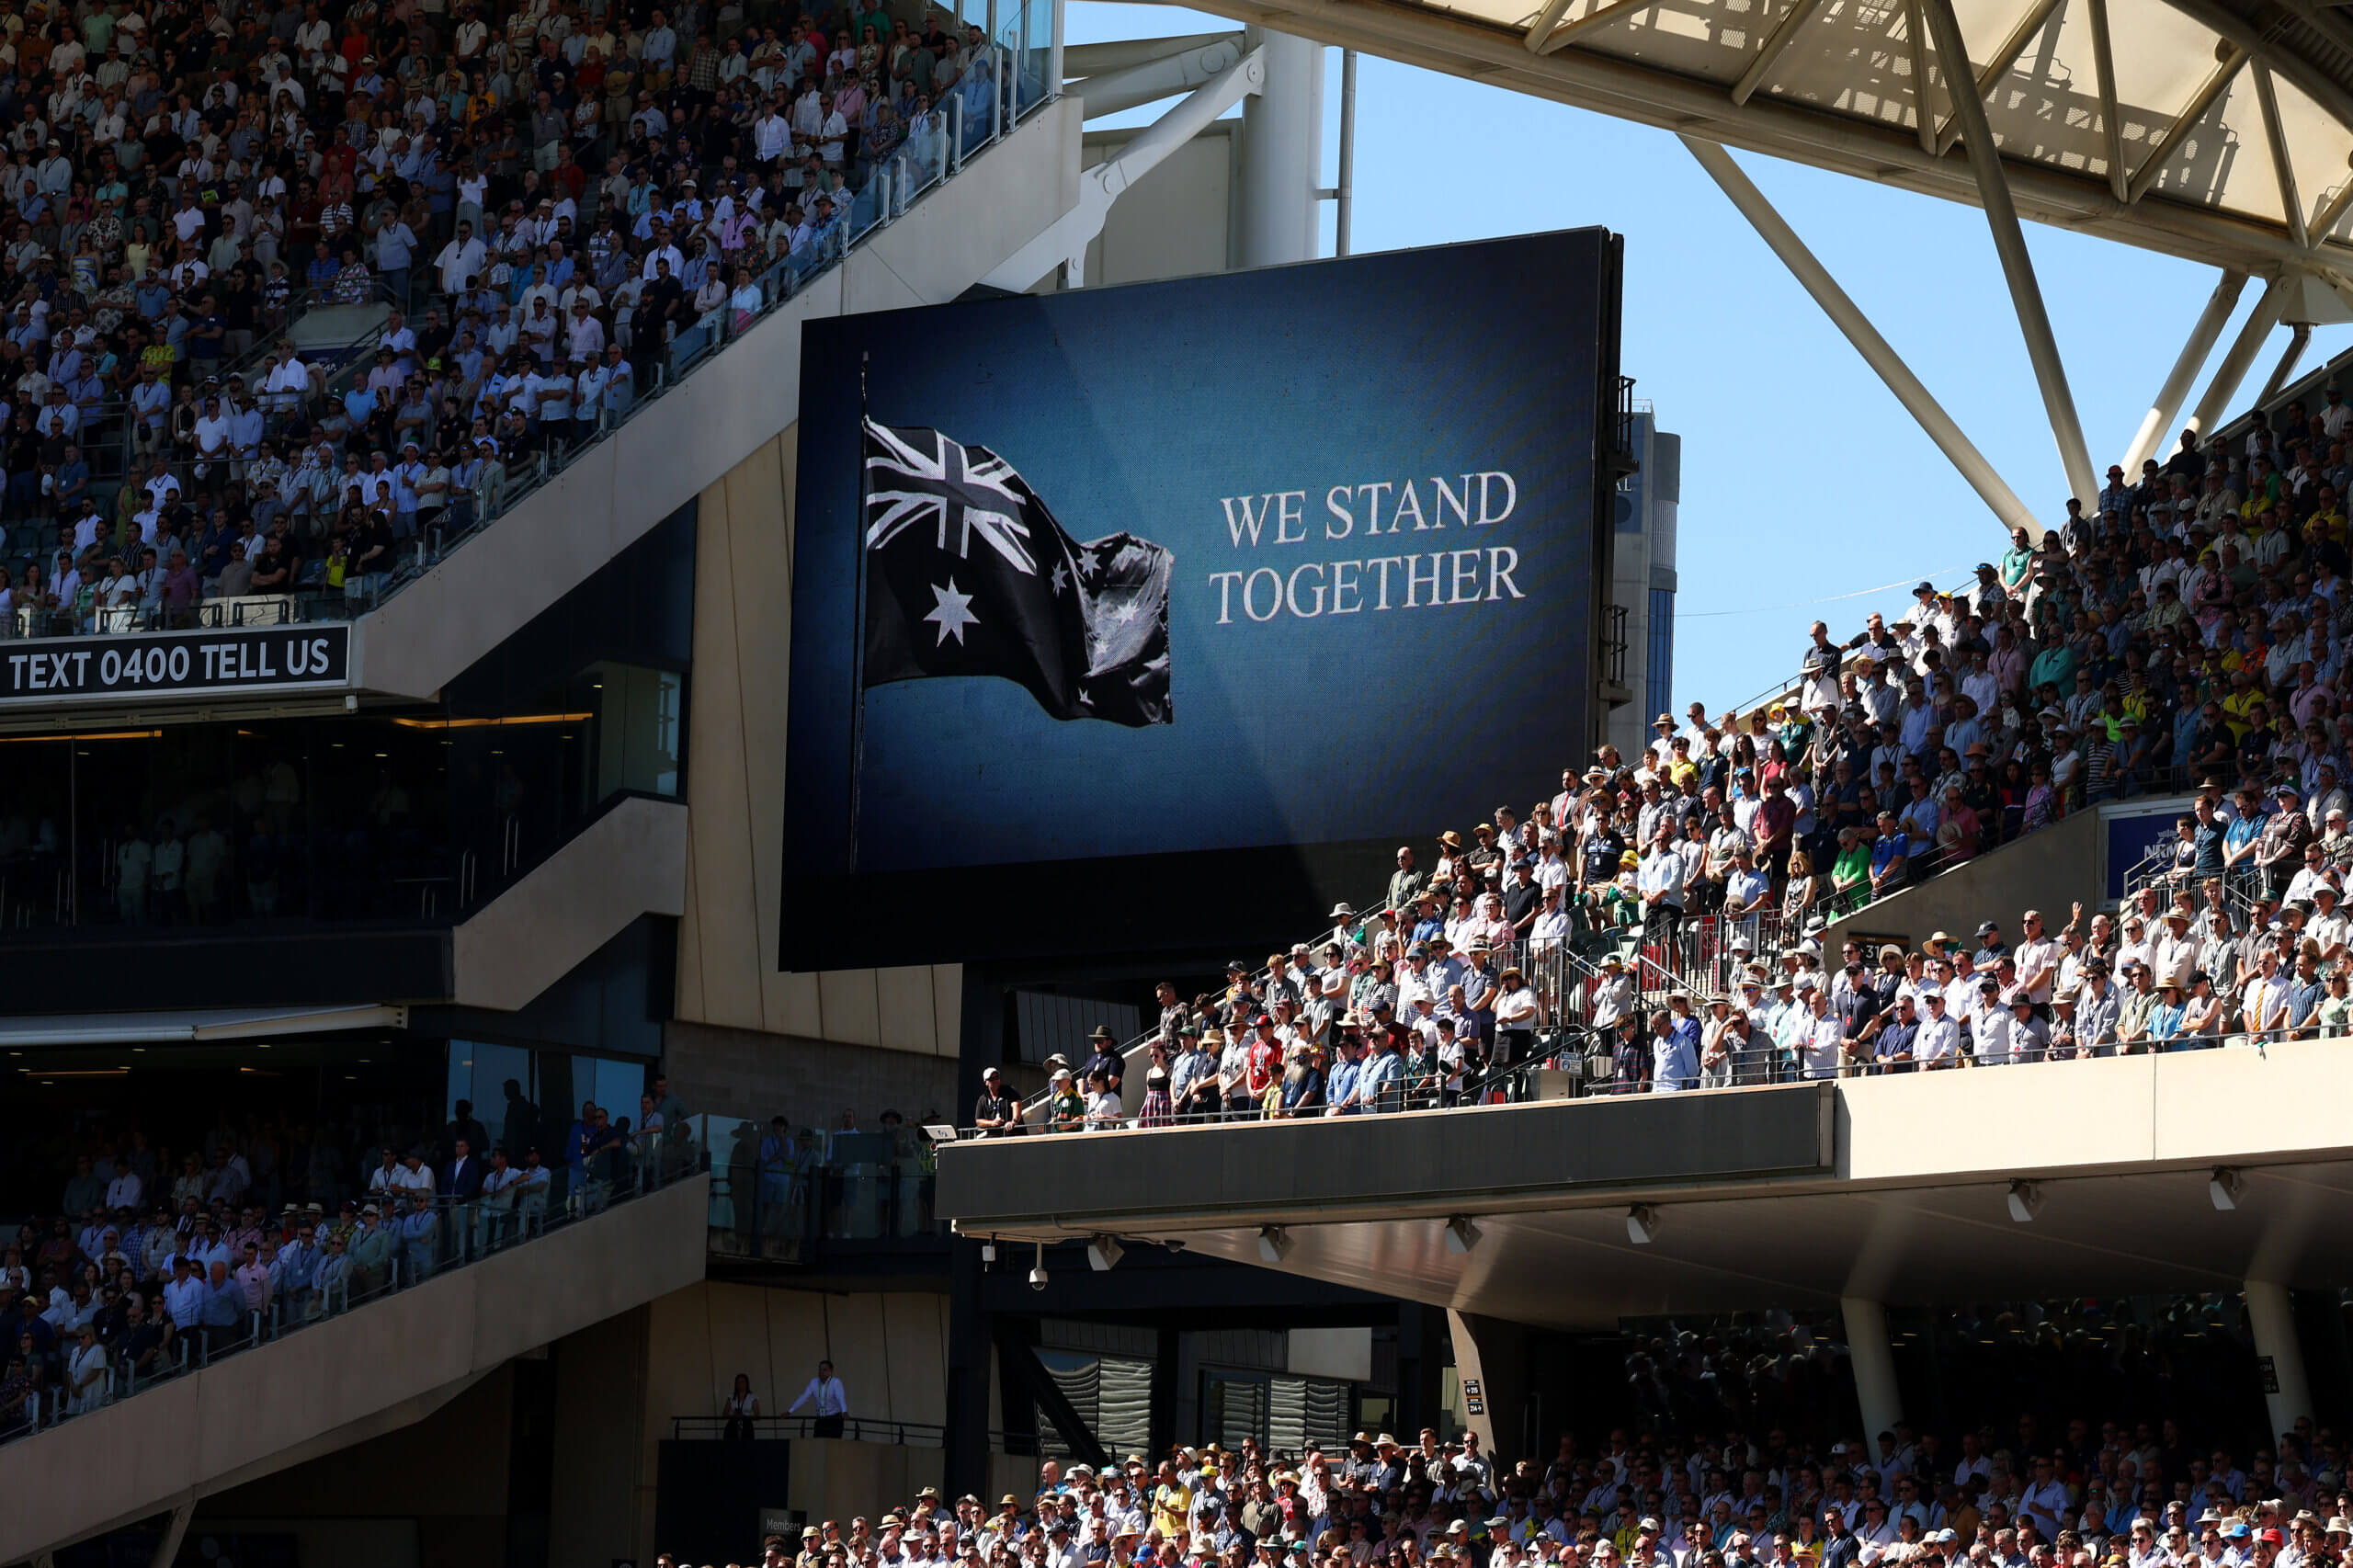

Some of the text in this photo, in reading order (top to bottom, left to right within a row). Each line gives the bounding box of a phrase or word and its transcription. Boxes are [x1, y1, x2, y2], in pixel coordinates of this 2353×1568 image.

[1220, 471, 1517, 549] WE STAND
[1208, 546, 1527, 625] TOGETHER
[8, 638, 329, 690] TEXT 0400 TELL US
[767, 1517, 801, 1532] Members
